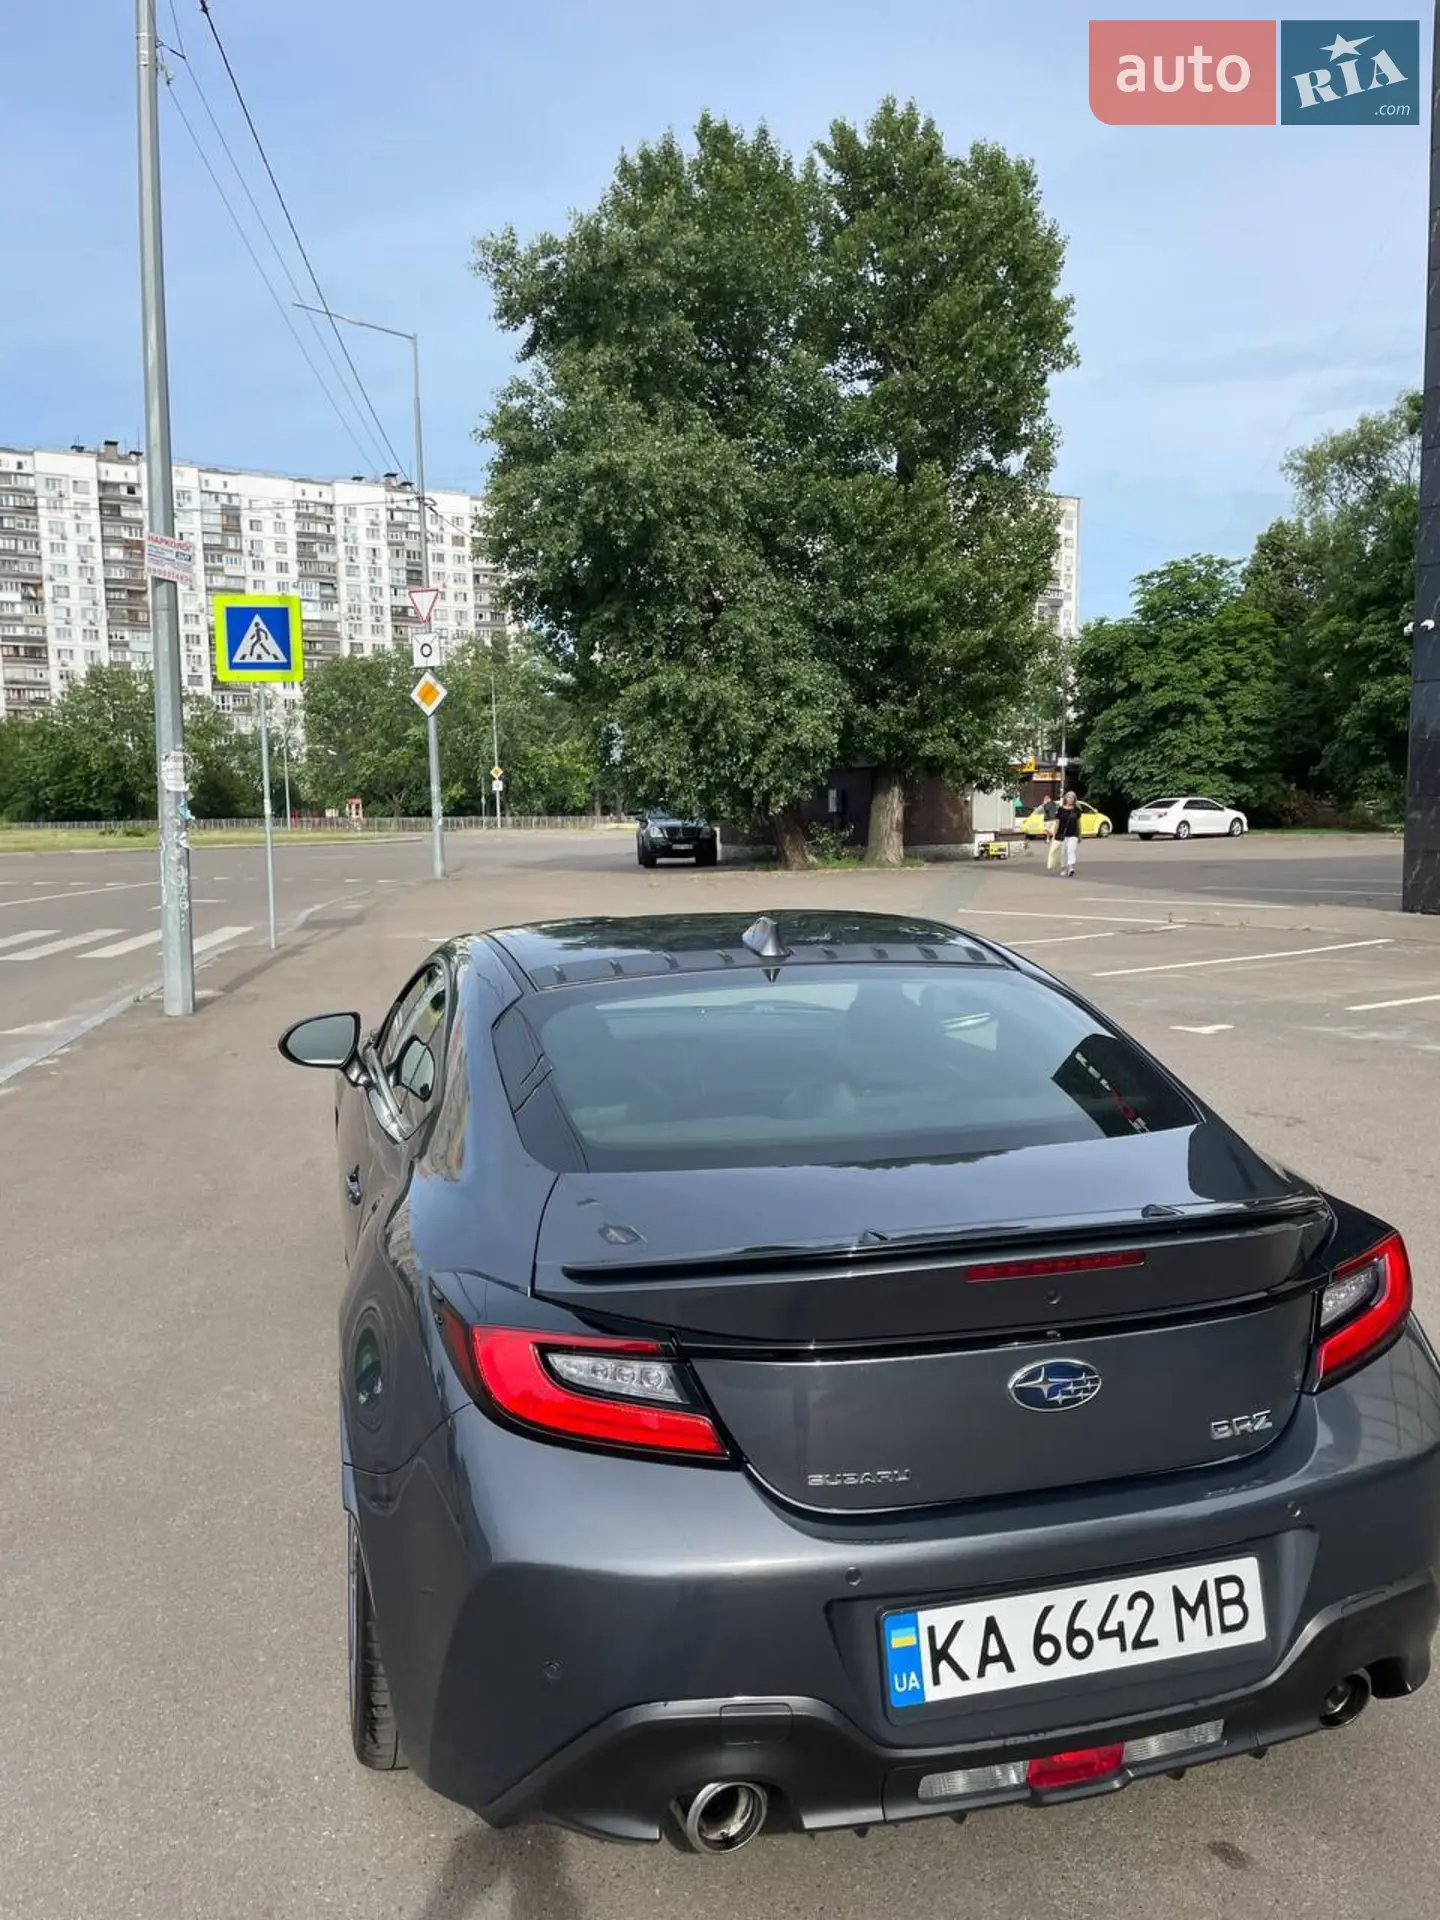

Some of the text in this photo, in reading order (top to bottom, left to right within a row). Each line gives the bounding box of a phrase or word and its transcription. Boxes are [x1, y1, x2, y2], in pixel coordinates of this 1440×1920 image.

[1210, 1409, 1273, 1440] BRZ
[807, 1468, 911, 1486] SUBARU
[927, 1574, 1250, 1687] KA 6642 MB
[894, 1673, 921, 1693] UA
